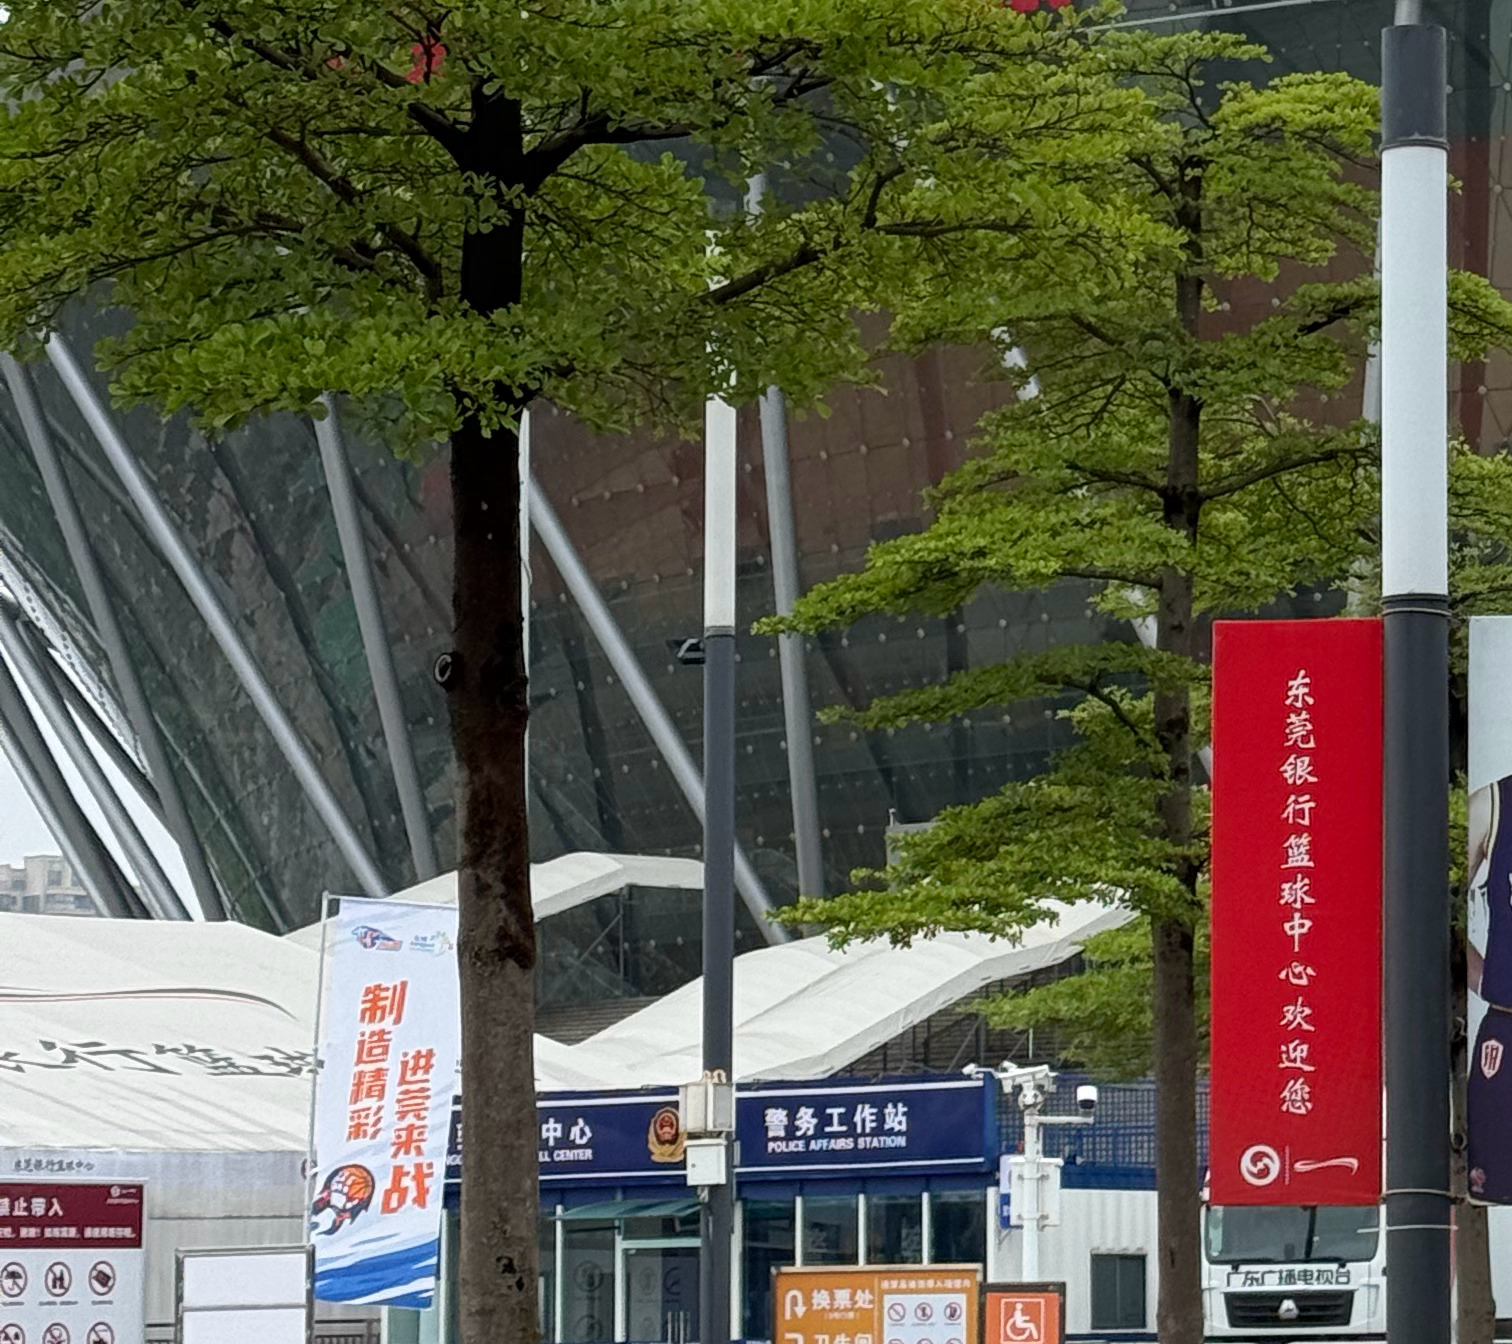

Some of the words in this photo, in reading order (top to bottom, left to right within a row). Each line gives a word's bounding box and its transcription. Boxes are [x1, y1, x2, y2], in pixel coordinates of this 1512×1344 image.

[1279, 668, 1318, 1116] 东莞银行篮球中心欢迎您
[346, 980, 408, 1141] 制造精彩
[380, 1048, 436, 1214] 进莞来战
[764, 1102, 908, 1138] 警务工作站
[553, 1149, 593, 1162] CENTER
[767, 1140, 806, 1153] POLICE
[809, 1138, 854, 1151] AFFAIRS
[857, 1136, 906, 1149] STATION
[1226, 1268, 1351, 1288] 广东广播电视台
[811, 1288, 874, 1311] 换票处
